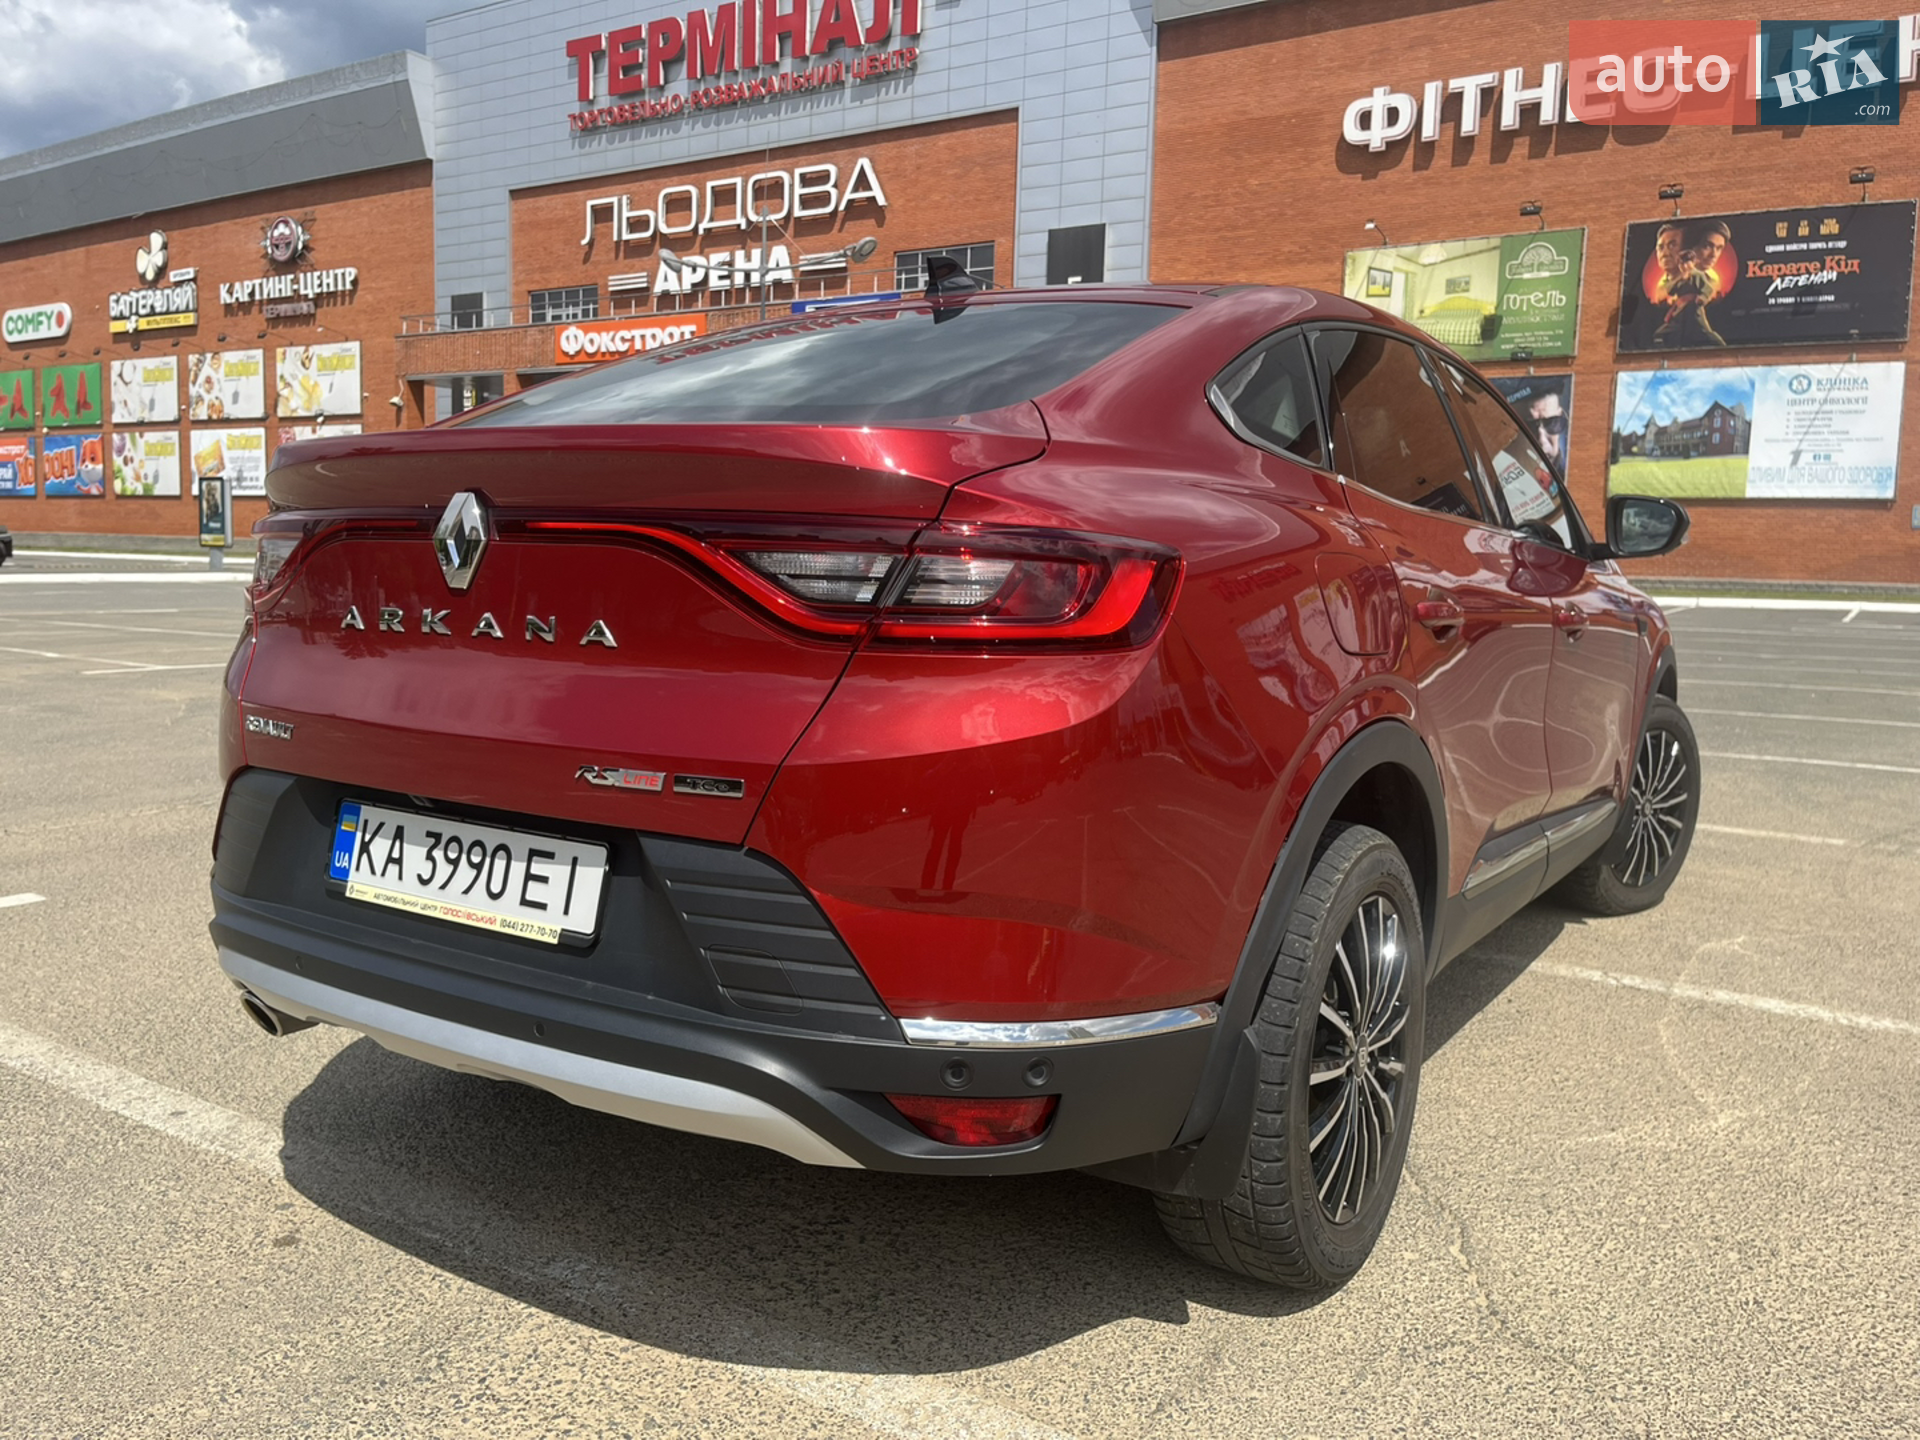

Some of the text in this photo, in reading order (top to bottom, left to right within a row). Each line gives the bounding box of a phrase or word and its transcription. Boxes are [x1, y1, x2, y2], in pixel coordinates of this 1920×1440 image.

[566, 0, 922, 102] ТЕРМІНАЛ
[567, 47, 920, 131] ТОРГОВЕЛЬНО-РОЗВАЖАЛЬНИЙ ЦЕНТР
[580, 157, 888, 246] ЛЬОДОВА
[219, 267, 357, 304] КАРТИНГ-ЦЕНТР
[653, 245, 794, 296] АРЕНА
[1745, 255, 1861, 280] Карате Кід
[109, 281, 194, 318] БАТТЕРФЛЯЙ
[5, 310, 54, 336] COMFY
[1816, 377, 1869, 387] КЛІНІКА
[340, 604, 619, 649] ARKANA
[623, 772, 661, 788] LINE
[334, 851, 349, 869] UA
[354, 818, 579, 917] KA 3990 EI
[499, 917, 519, 931] (044)
[519, 922, 558, 940] 277-70-70
